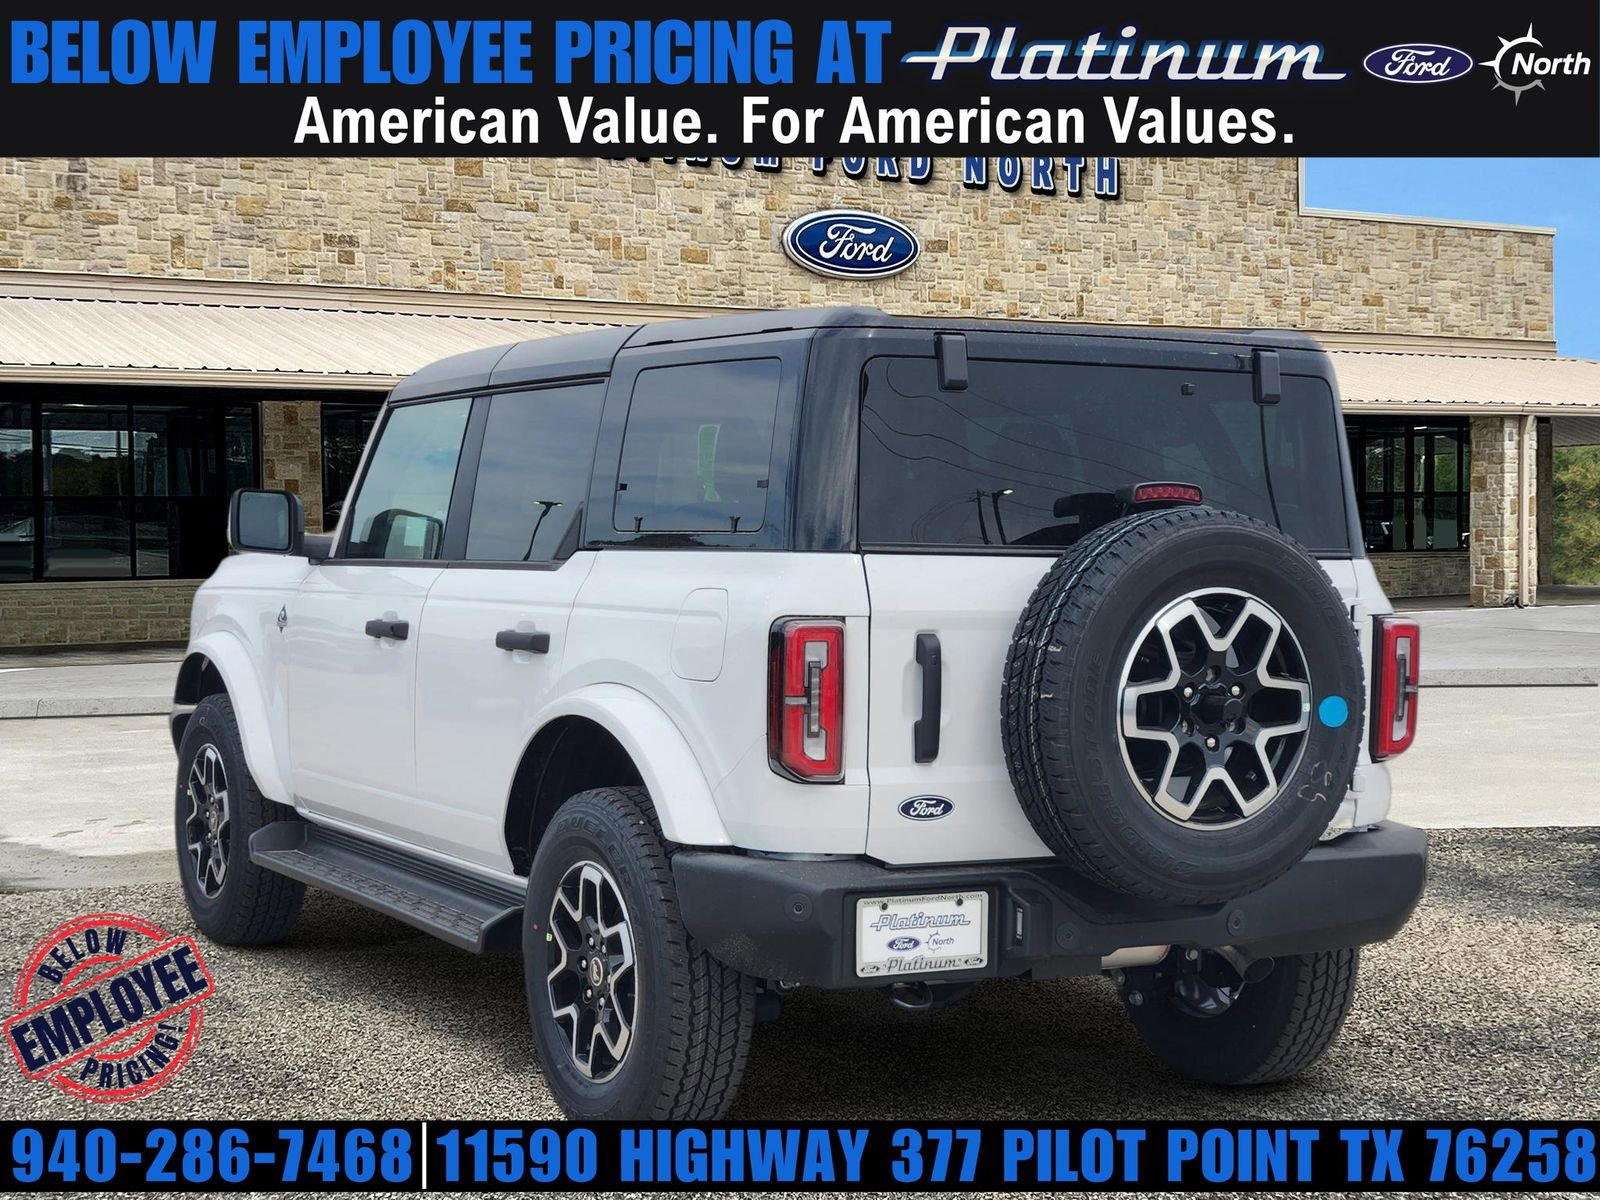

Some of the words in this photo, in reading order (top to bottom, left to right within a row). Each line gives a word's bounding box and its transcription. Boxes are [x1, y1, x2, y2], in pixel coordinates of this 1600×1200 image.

[963, 157, 1119, 196] NORTH
[819, 223, 894, 262] Ford
[909, 799, 945, 816] Ford
[870, 912, 971, 931] Platinum
[892, 937, 916, 950] Ford
[931, 936, 955, 946] North
[886, 955, 962, 973] Platinum
